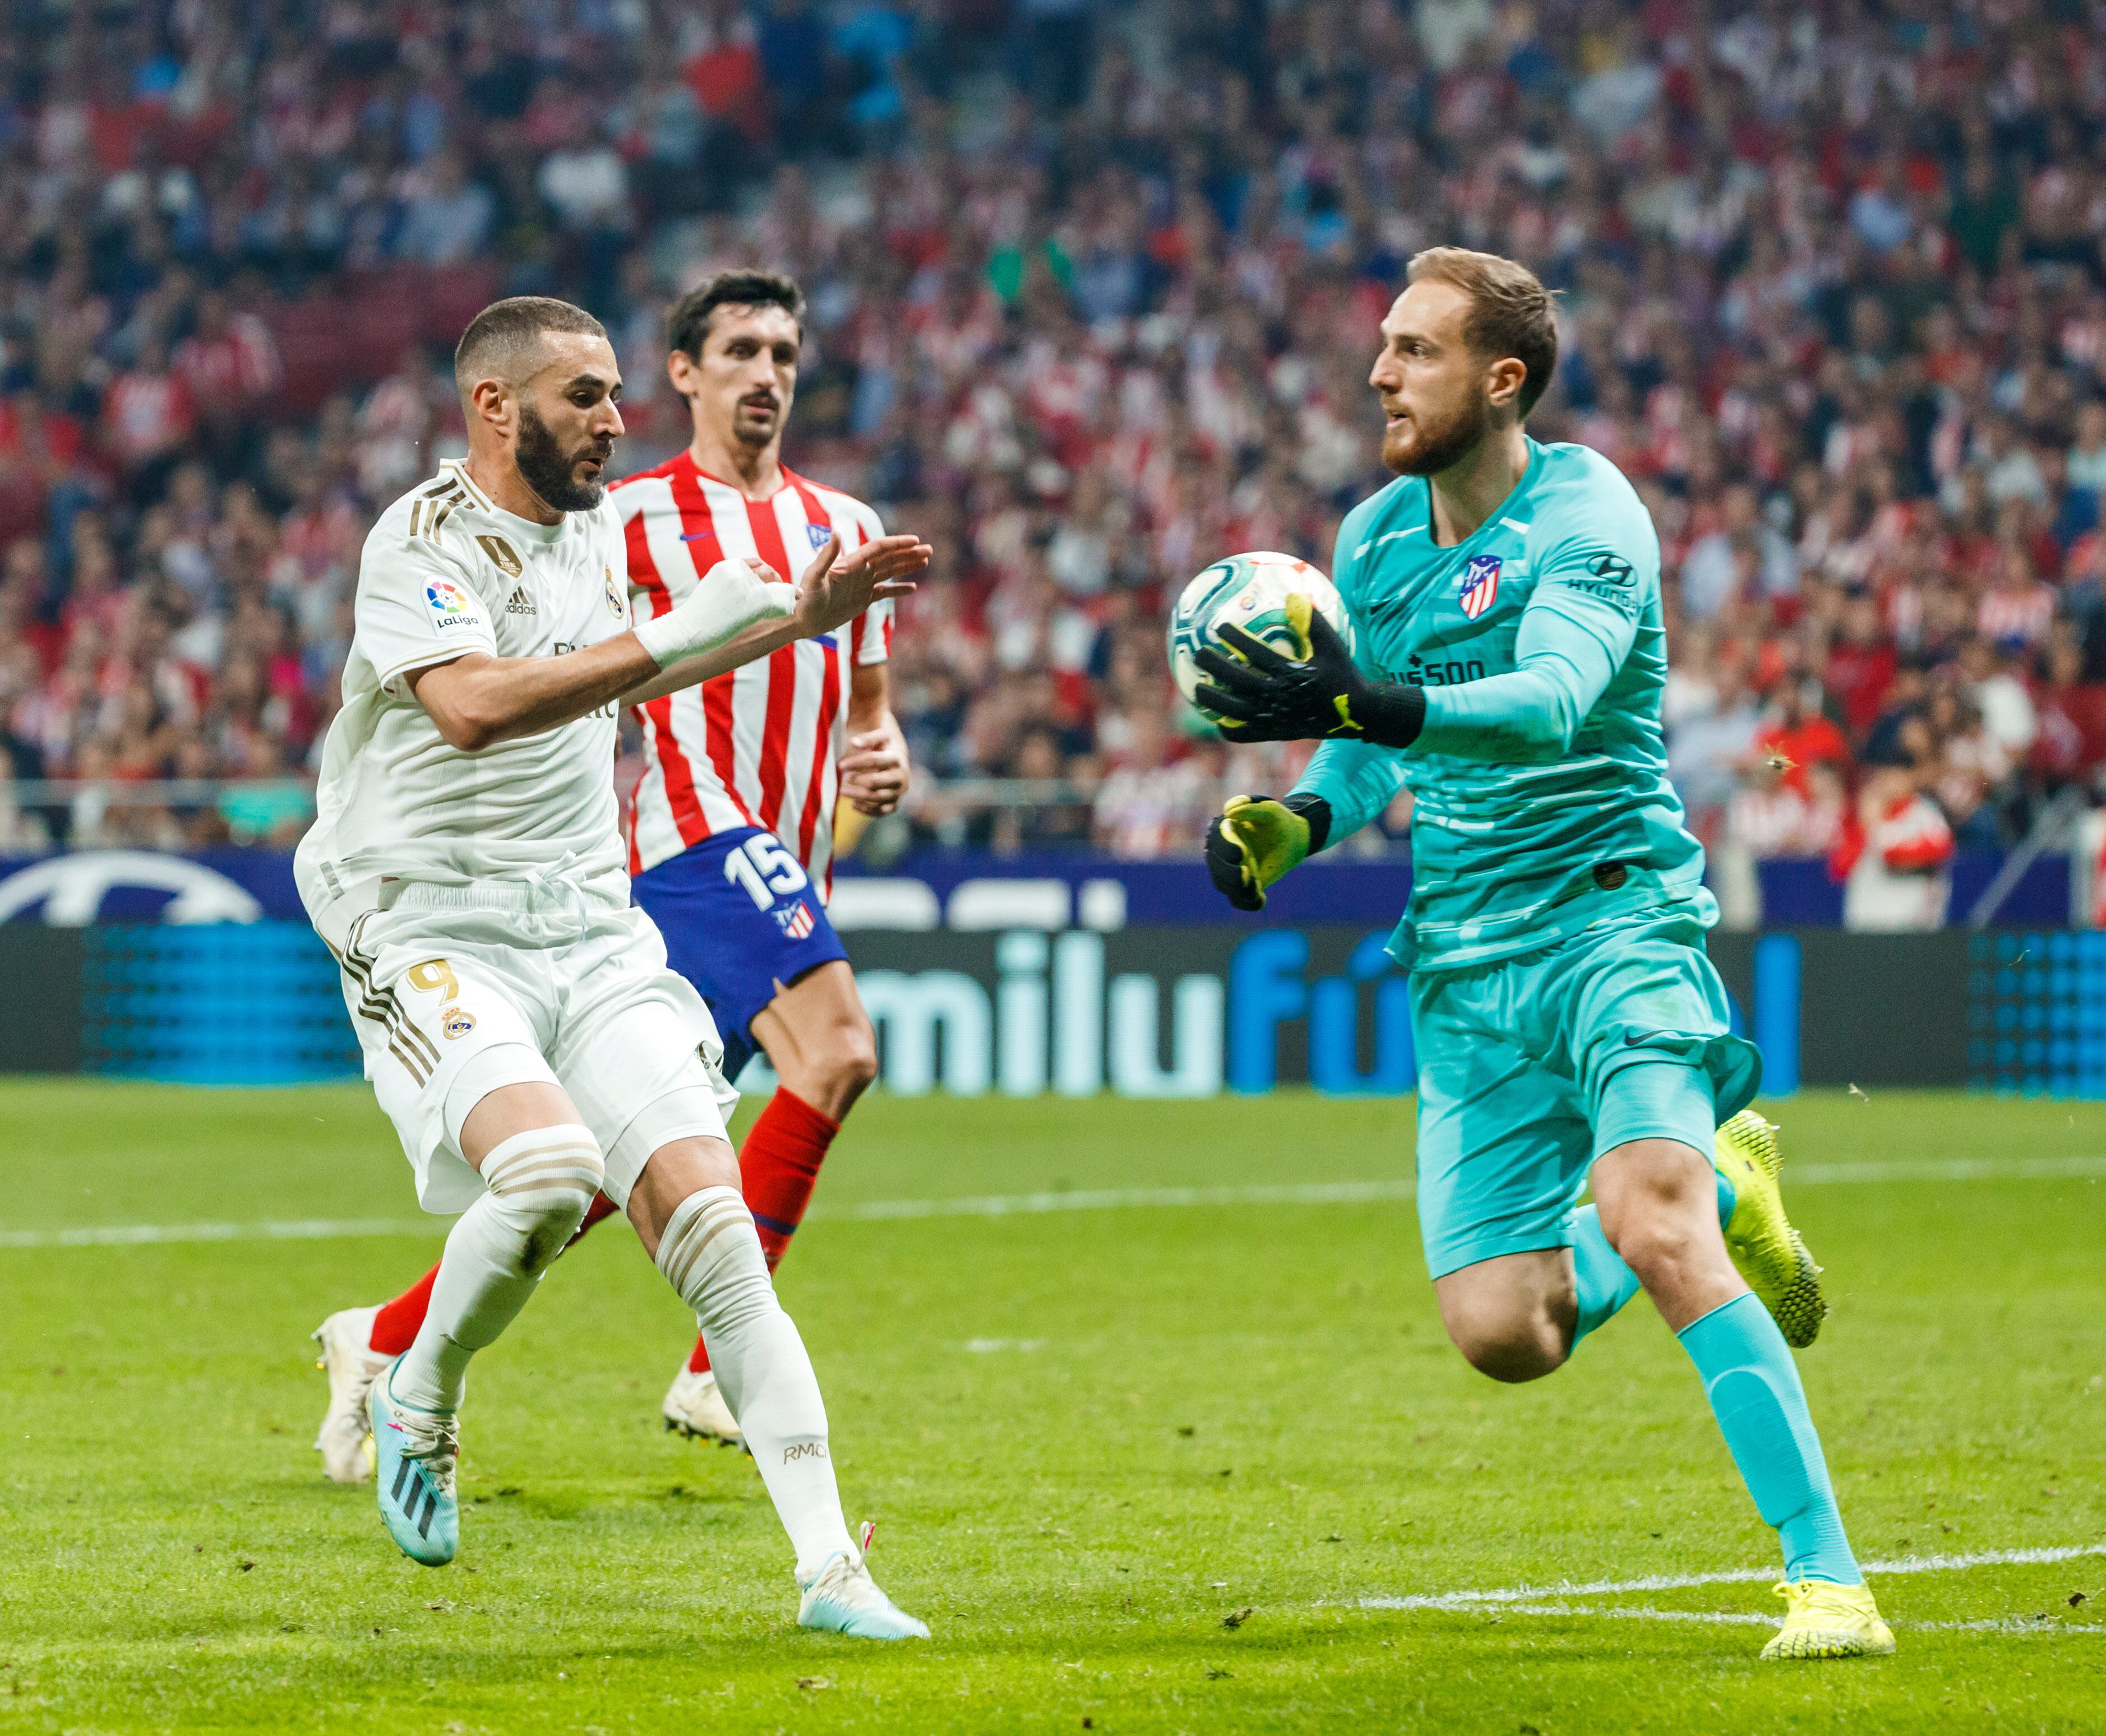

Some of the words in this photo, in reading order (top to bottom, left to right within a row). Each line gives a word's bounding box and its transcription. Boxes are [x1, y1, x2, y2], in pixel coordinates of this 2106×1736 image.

[437, 615, 479, 628] LaLiga
[723, 833, 808, 912] 15
[405, 959, 459, 1007] 9
